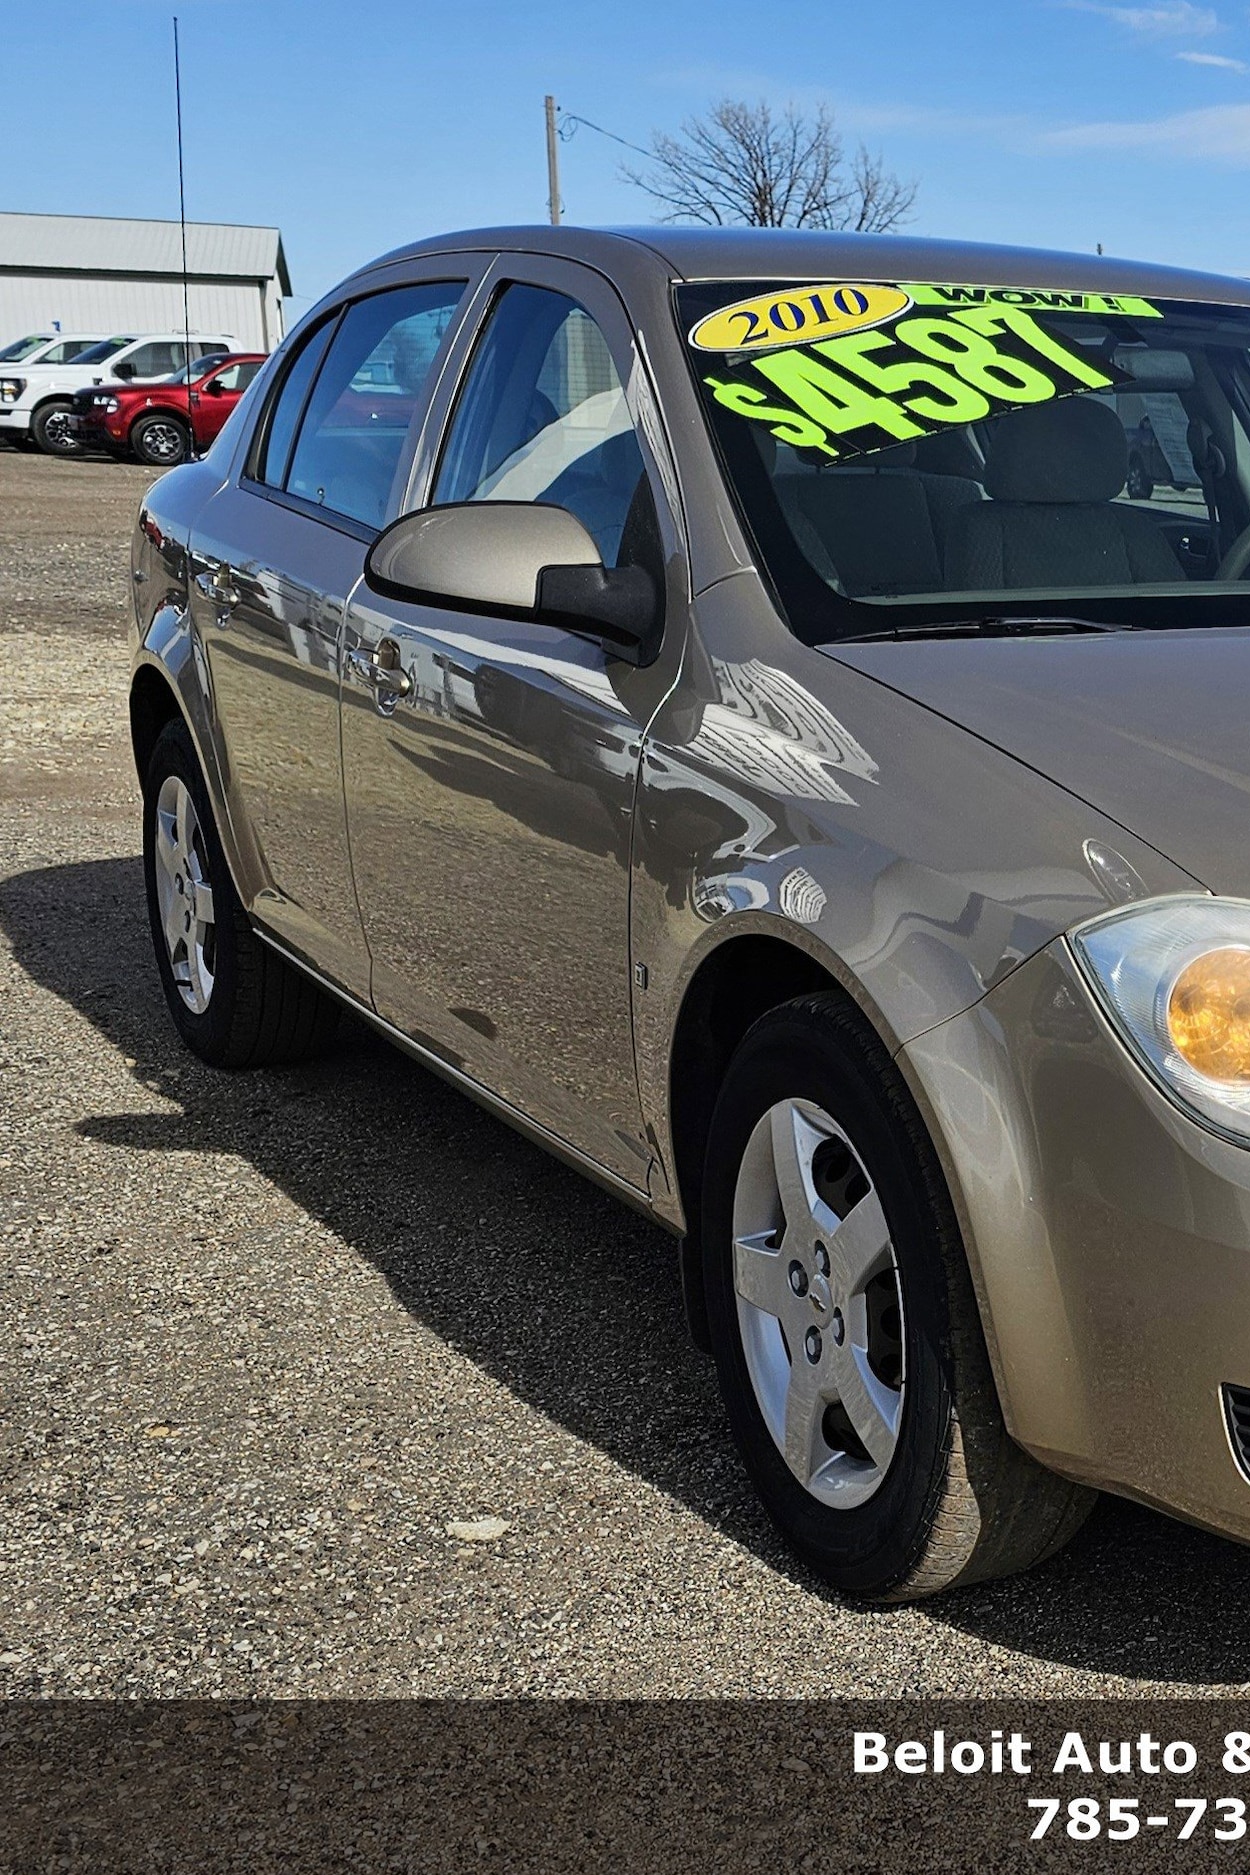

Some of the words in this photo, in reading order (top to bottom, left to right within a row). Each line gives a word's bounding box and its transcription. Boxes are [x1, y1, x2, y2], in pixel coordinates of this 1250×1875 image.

[728, 287, 870, 345] 2010
[930, 287, 1090, 309] WOW
[702, 306, 1114, 457] $4587
